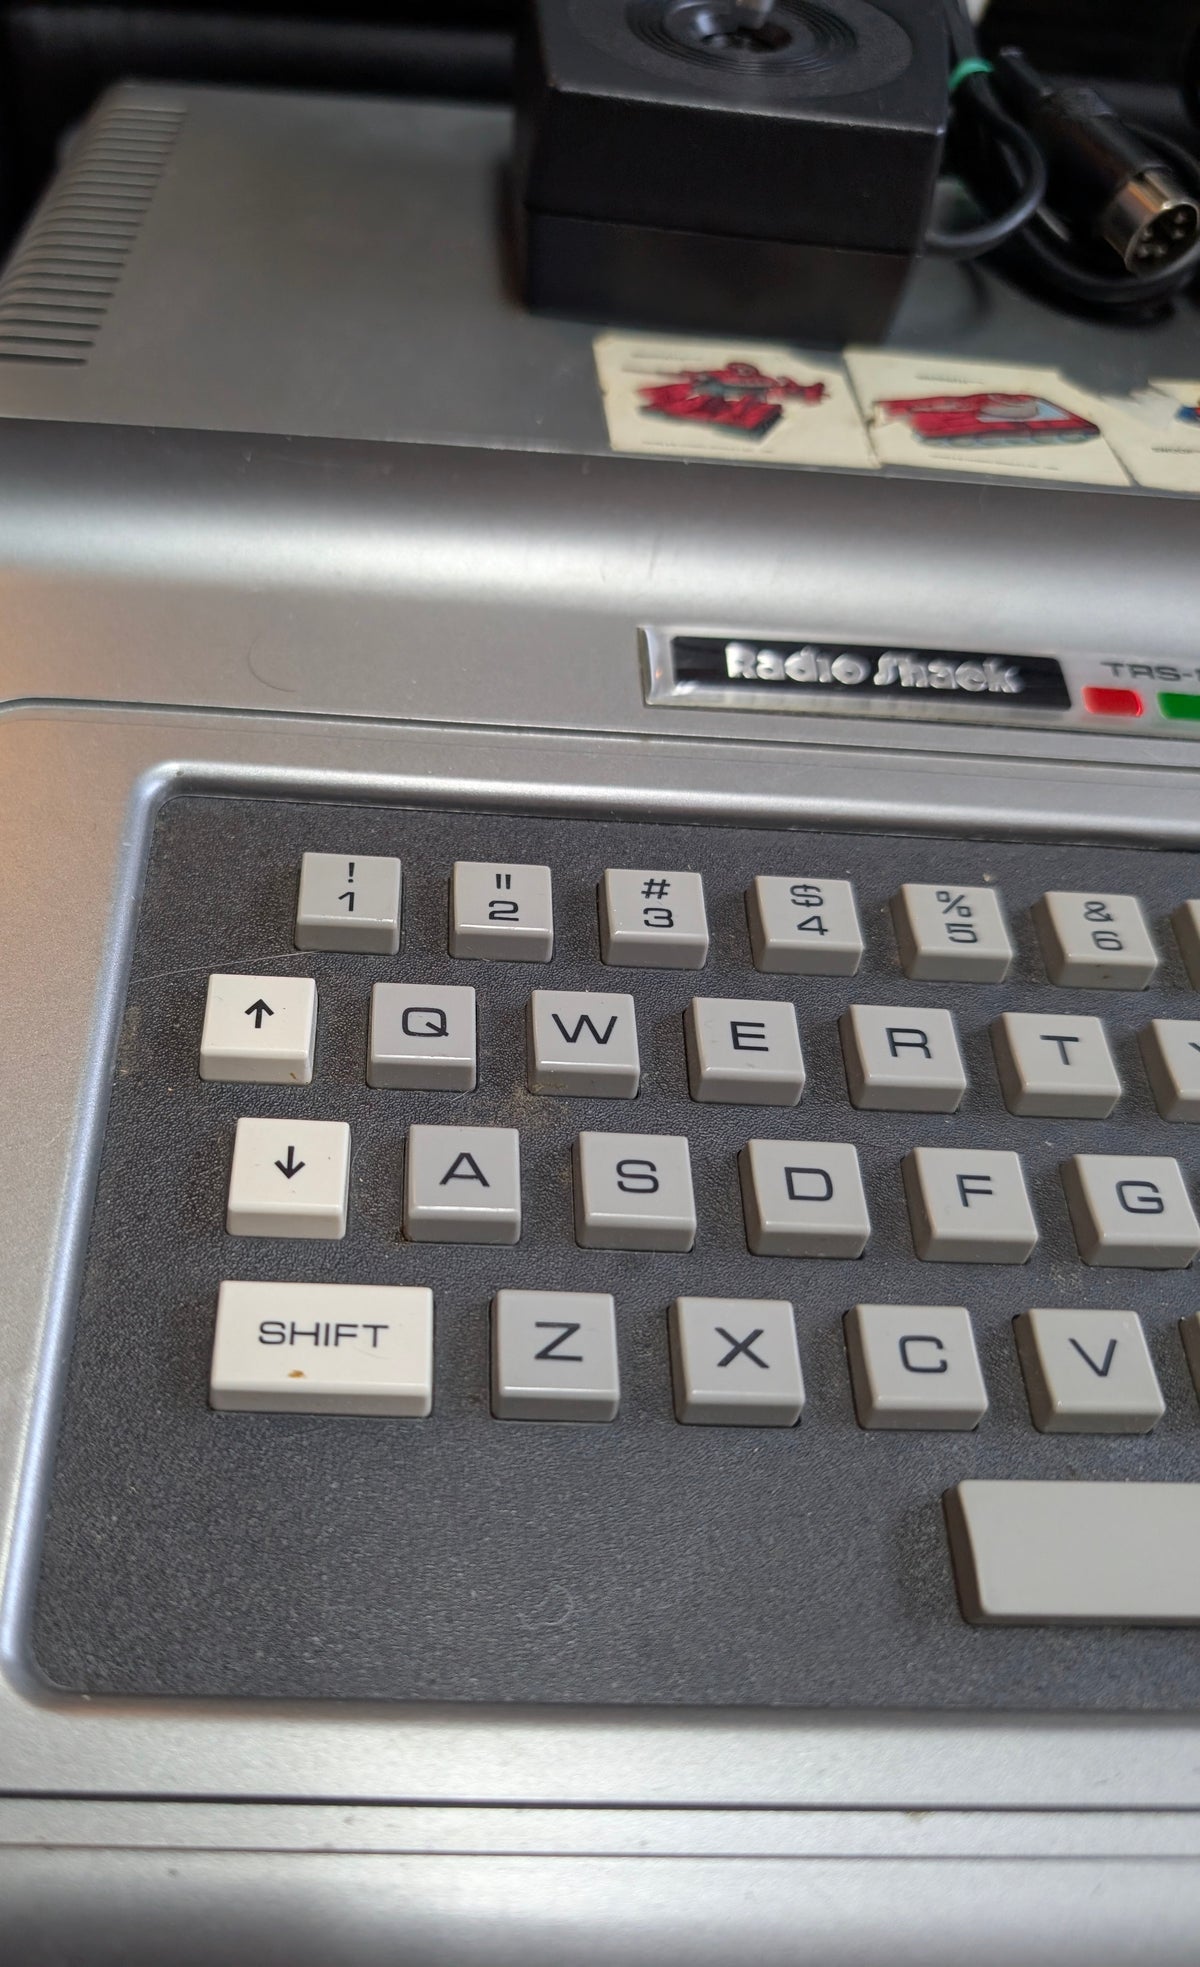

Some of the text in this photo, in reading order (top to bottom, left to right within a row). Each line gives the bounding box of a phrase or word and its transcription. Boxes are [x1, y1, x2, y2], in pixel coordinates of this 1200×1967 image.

[724, 641, 1025, 694] Radio Shack
[1099, 661, 1200, 682] TRS-
[337, 891, 355, 912] 1
[488, 900, 520, 922] 2
[642, 907, 675, 929] 3
[797, 915, 829, 937] 4
[945, 922, 979, 945] 5
[1091, 930, 1124, 952] 6
[401, 1006, 449, 1038] Q
[551, 1013, 618, 1045] W
[729, 1020, 769, 1052] E
[885, 1027, 932, 1059] R
[1040, 1034, 1080, 1066] T
[439, 1152, 491, 1188] A
[615, 1159, 660, 1194] S
[783, 1166, 834, 1202] D
[956, 1174, 993, 1208] F
[1115, 1180, 1165, 1215] G
[258, 1320, 390, 1349] SHIFT
[533, 1321, 584, 1363] Z
[714, 1326, 771, 1370] X
[898, 1335, 949, 1374] C
[1068, 1338, 1118, 1378] V
